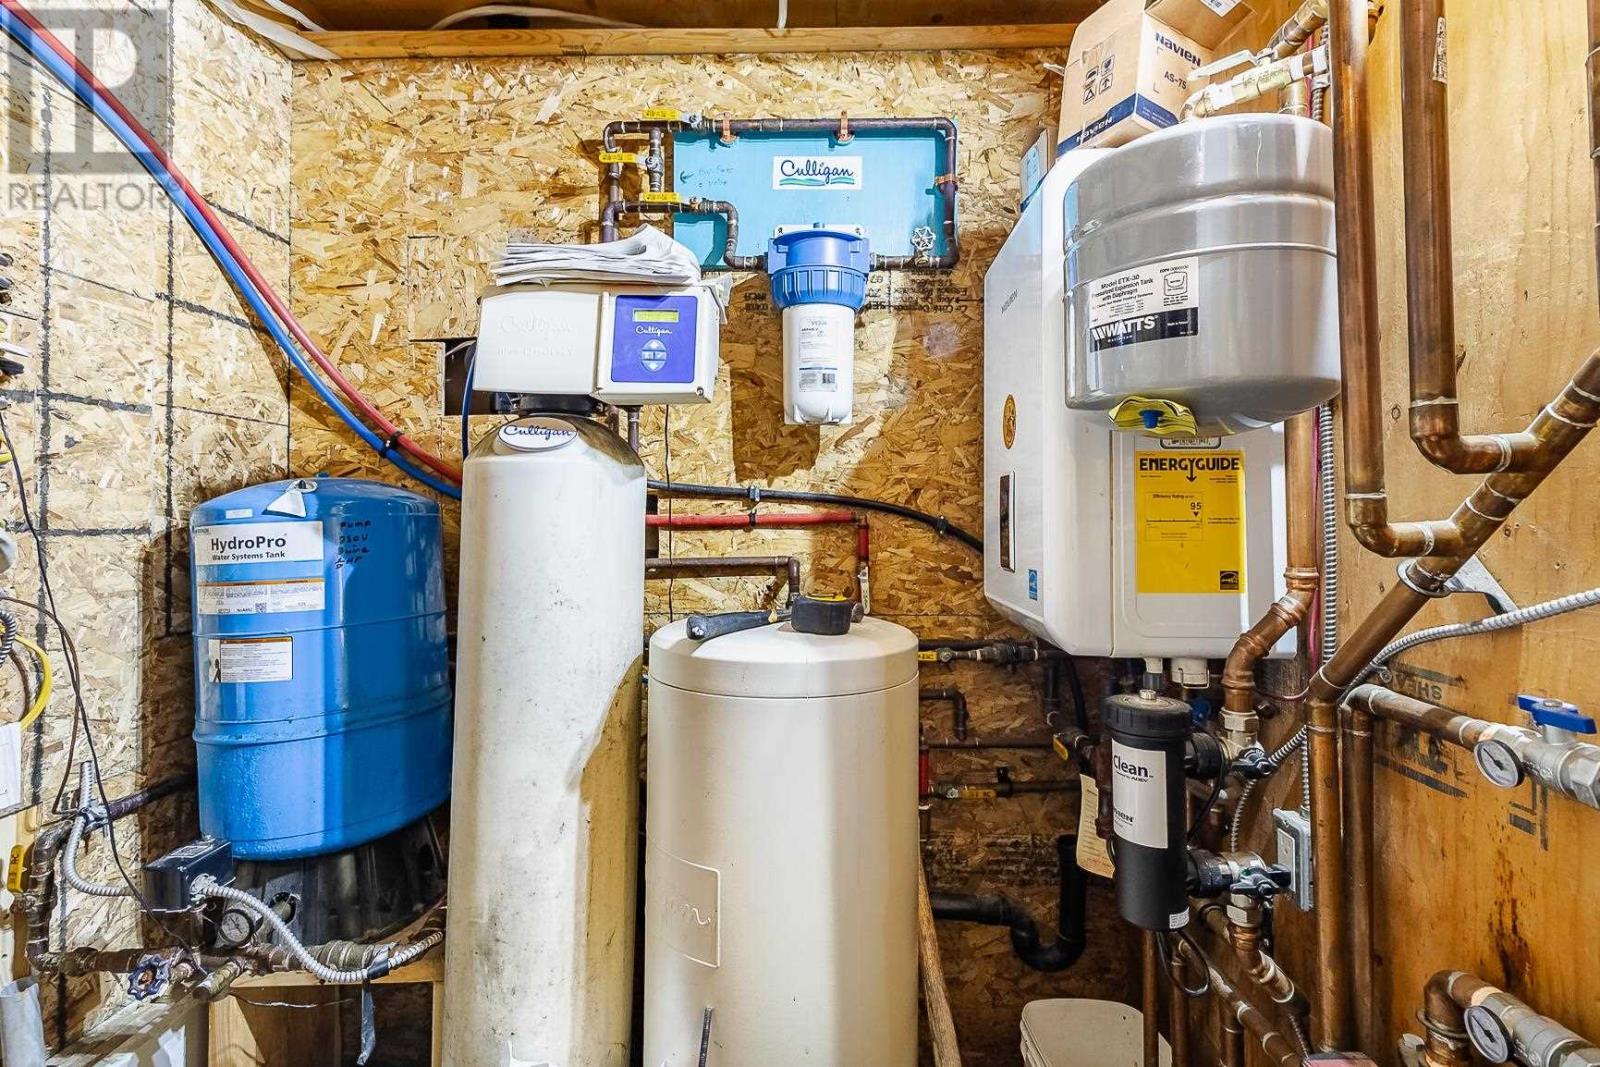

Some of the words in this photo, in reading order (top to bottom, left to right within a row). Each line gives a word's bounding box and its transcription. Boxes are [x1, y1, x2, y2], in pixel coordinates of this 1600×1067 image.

[1163, 71, 1188, 90] AS-75
[780, 159, 854, 185] Culligan
[636, 325, 673, 340] Culligan
[1092, 315, 1156, 341] WATTS
[503, 425, 573, 440] Culligan
[1139, 457, 1240, 473] ENERGYGUIDE
[1190, 501, 1202, 511] 95
[210, 536, 287, 553] HydroPro
[231, 552, 264, 562] Systems
[265, 550, 286, 559] Tank
